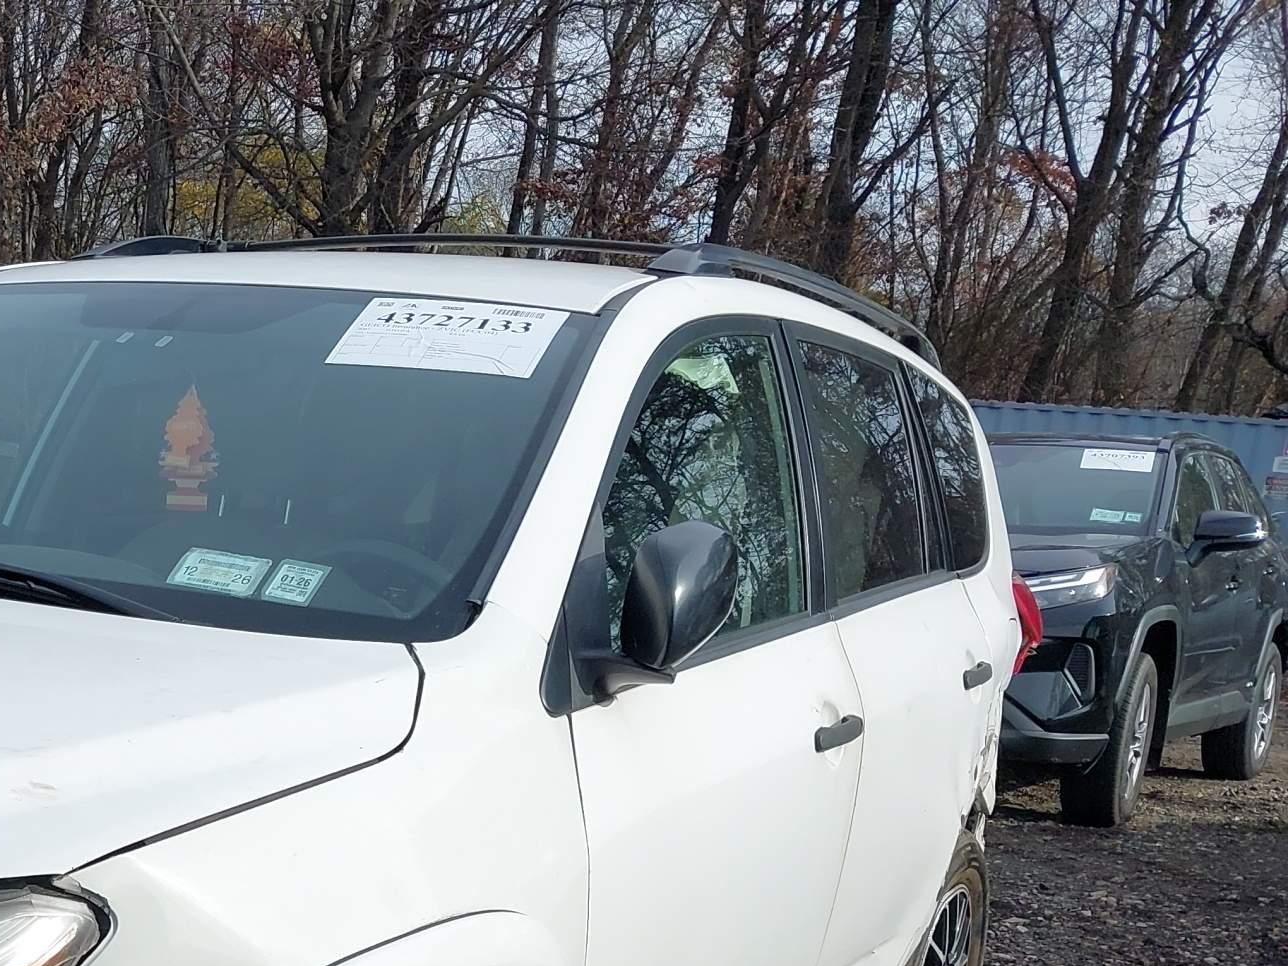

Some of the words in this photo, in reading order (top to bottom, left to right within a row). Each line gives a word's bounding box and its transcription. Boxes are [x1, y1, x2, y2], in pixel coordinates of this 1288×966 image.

[376, 311, 533, 334] 43727133
[183, 565, 198, 577] 12
[231, 574, 252, 586] 26
